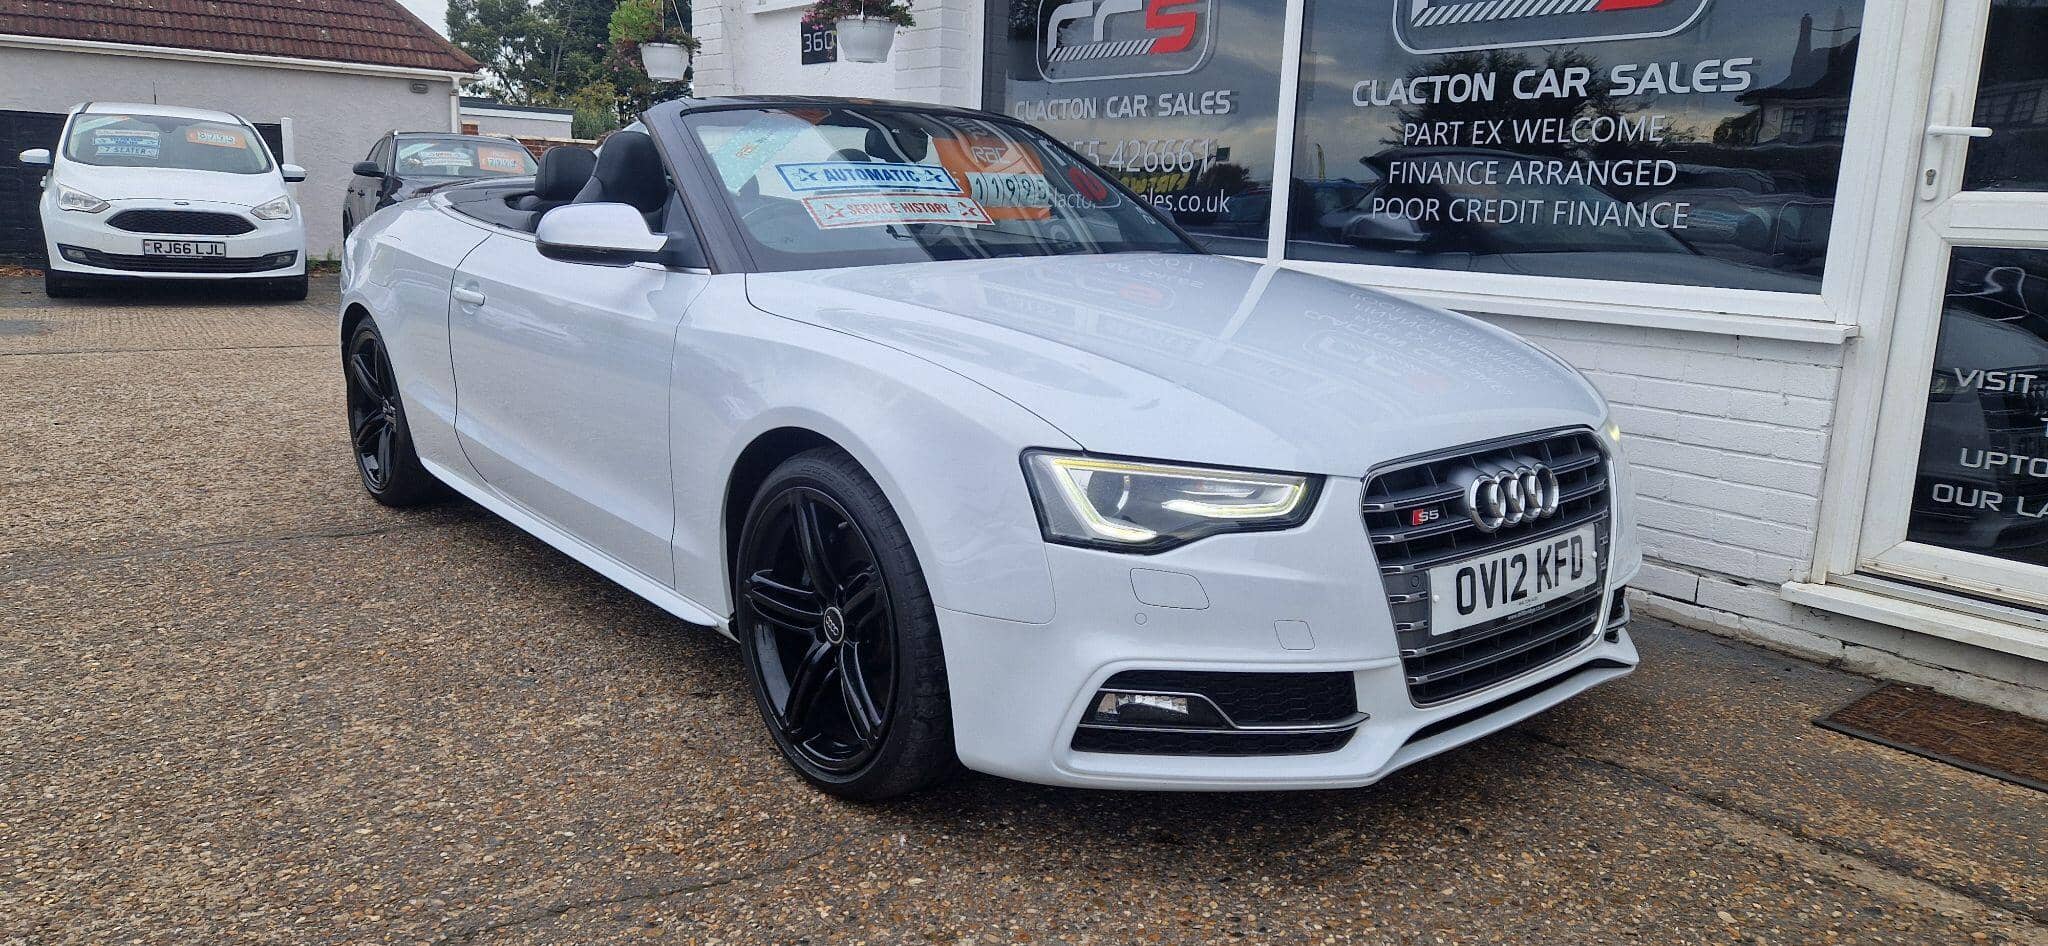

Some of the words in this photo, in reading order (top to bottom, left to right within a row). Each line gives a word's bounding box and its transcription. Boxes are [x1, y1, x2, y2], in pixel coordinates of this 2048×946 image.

[803, 31, 835, 53] 360
[1352, 71, 1497, 107] CLACTON
[1512, 66, 1590, 100] CAR
[1609, 57, 1754, 97] SALES
[1014, 96, 1098, 121] CLACTON
[1106, 94, 1148, 119] CAR
[1158, 89, 1232, 117] SALES
[1403, 120, 1465, 146] PART
[1472, 119, 1505, 145] EX
[1512, 114, 1667, 144] WELCOME
[1107, 136, 1212, 173] 426661
[823, 168, 921, 183] AUTOMATIC
[1388, 160, 1499, 185] FINANCE
[1506, 159, 1678, 186] ARRANGED
[975, 177, 1048, 201] 11995
[849, 201, 900, 216] SERVICE
[900, 202, 951, 214] HISTORY
[1371, 196, 1441, 222] POOR
[1449, 197, 1545, 224] CREDIT
[1552, 199, 1691, 230] FINANCE
[153, 242, 192, 254] RJ66
[195, 243, 224, 256] LJL
[1954, 367, 2038, 394] VISIT
[1932, 483, 2003, 512] OUR
[1418, 509, 1440, 523] S5
[1455, 552, 1528, 616] OV12
[1536, 534, 1584, 594] KFD
